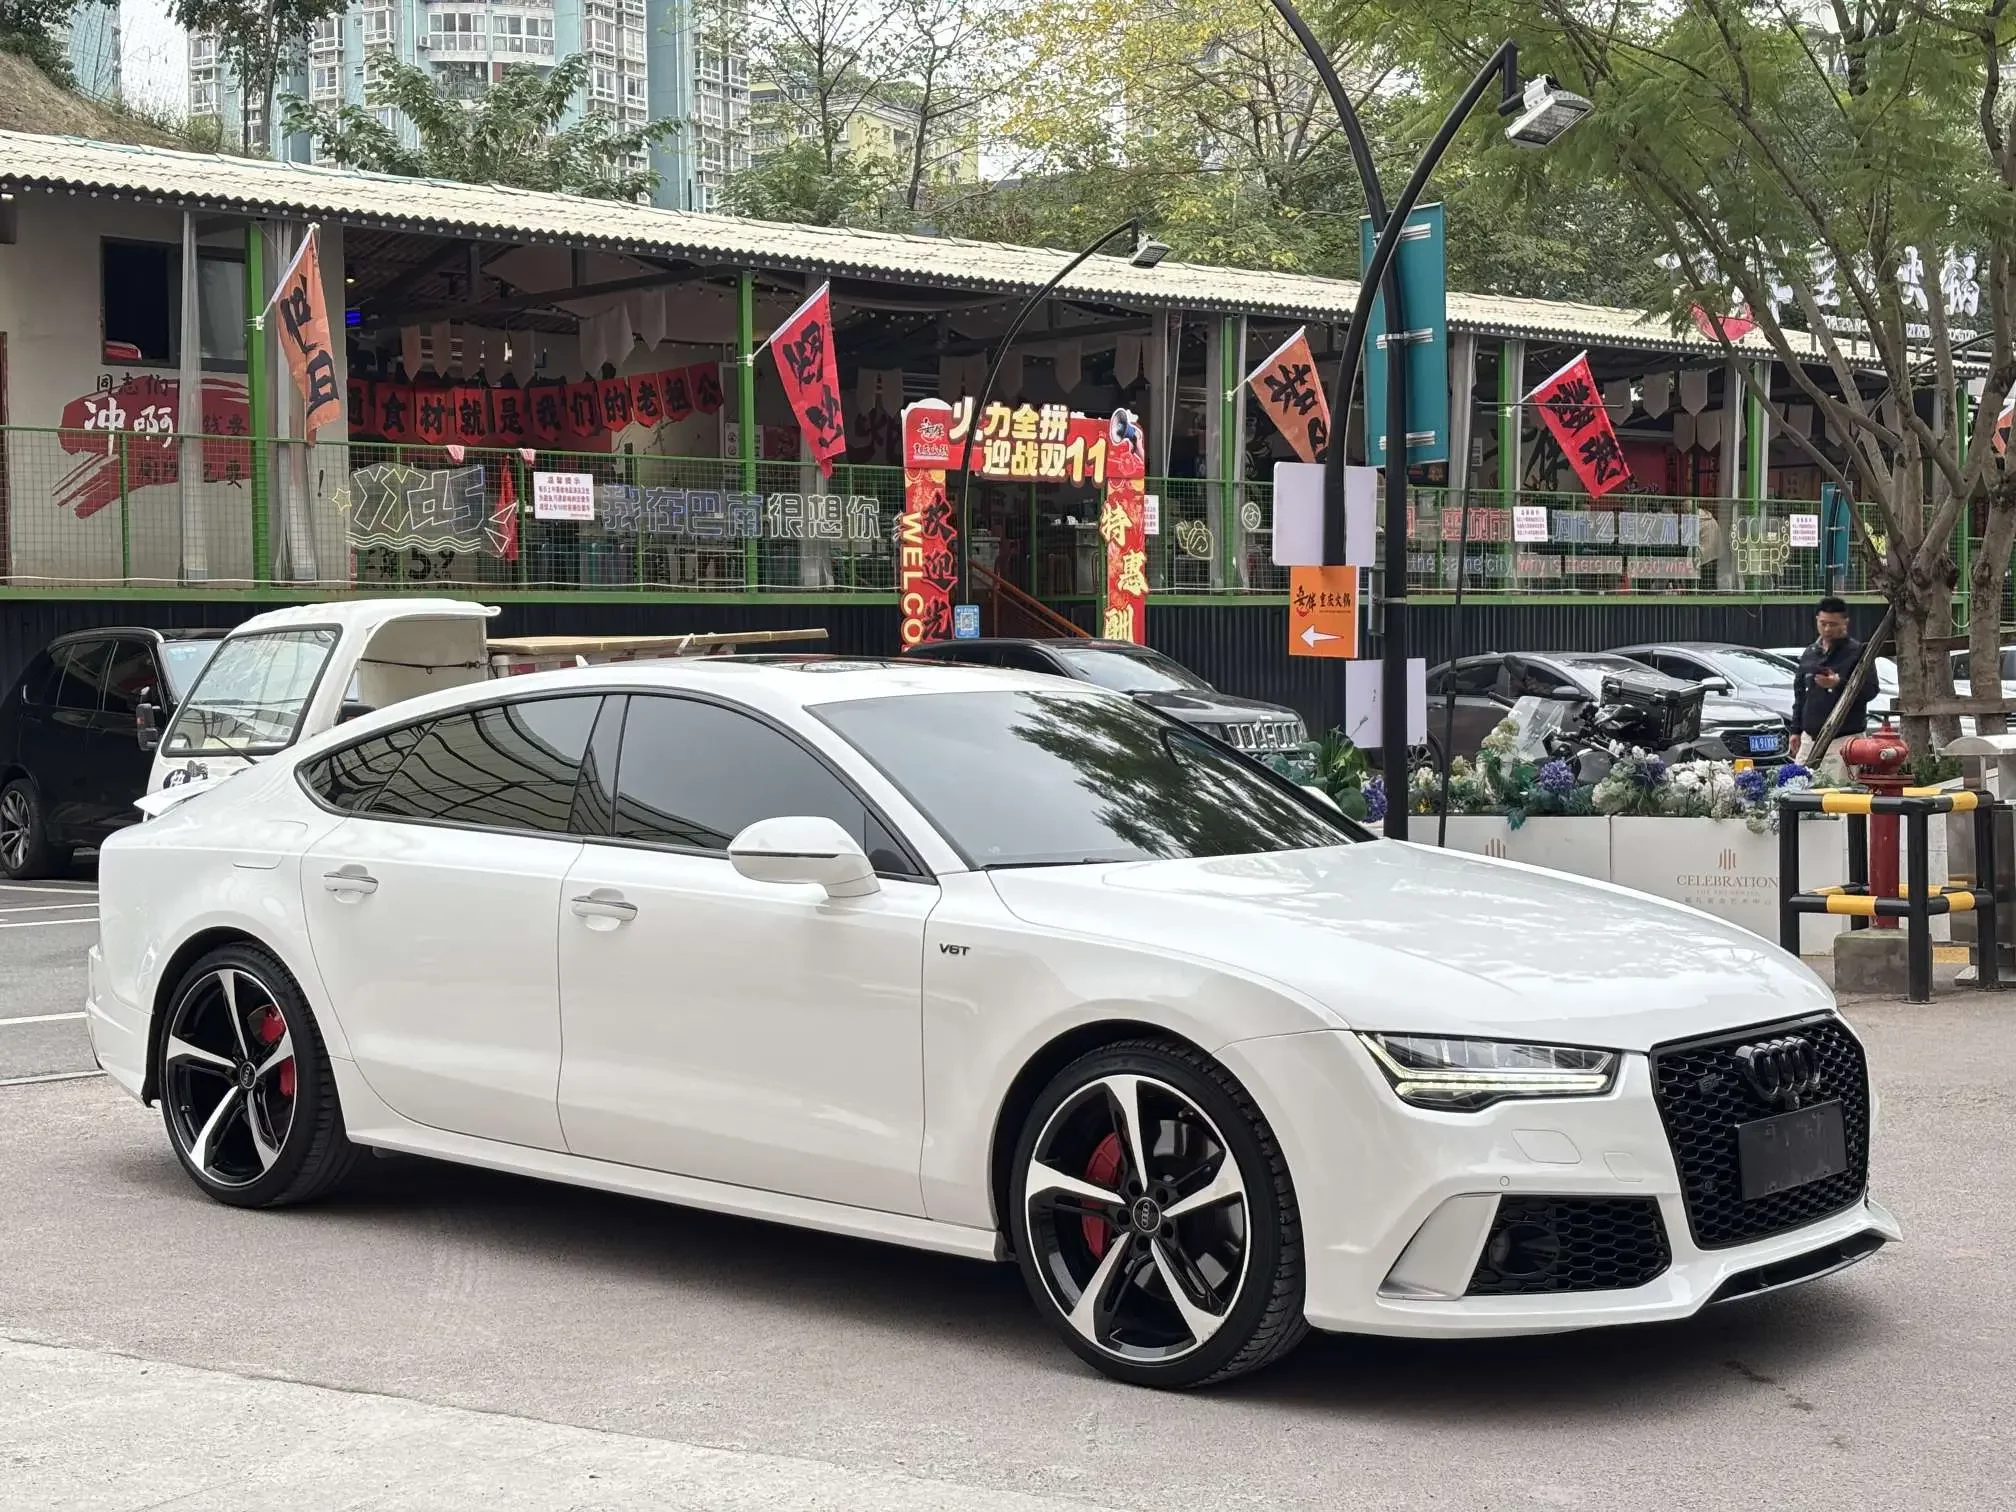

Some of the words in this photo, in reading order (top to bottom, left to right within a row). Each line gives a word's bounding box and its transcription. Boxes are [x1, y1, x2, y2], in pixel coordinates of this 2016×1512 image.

[84, 397, 175, 457] 冲啊
[950, 396, 1068, 442] 火力全拼
[983, 438, 1107, 484] 迎战双11
[601, 484, 881, 539] 我在巴南很想你
[901, 512, 925, 649] WELCO
[1737, 548, 1784, 576] BEER
[1676, 874, 1779, 888] CELEBRATION
[939, 943, 971, 956] V6T
